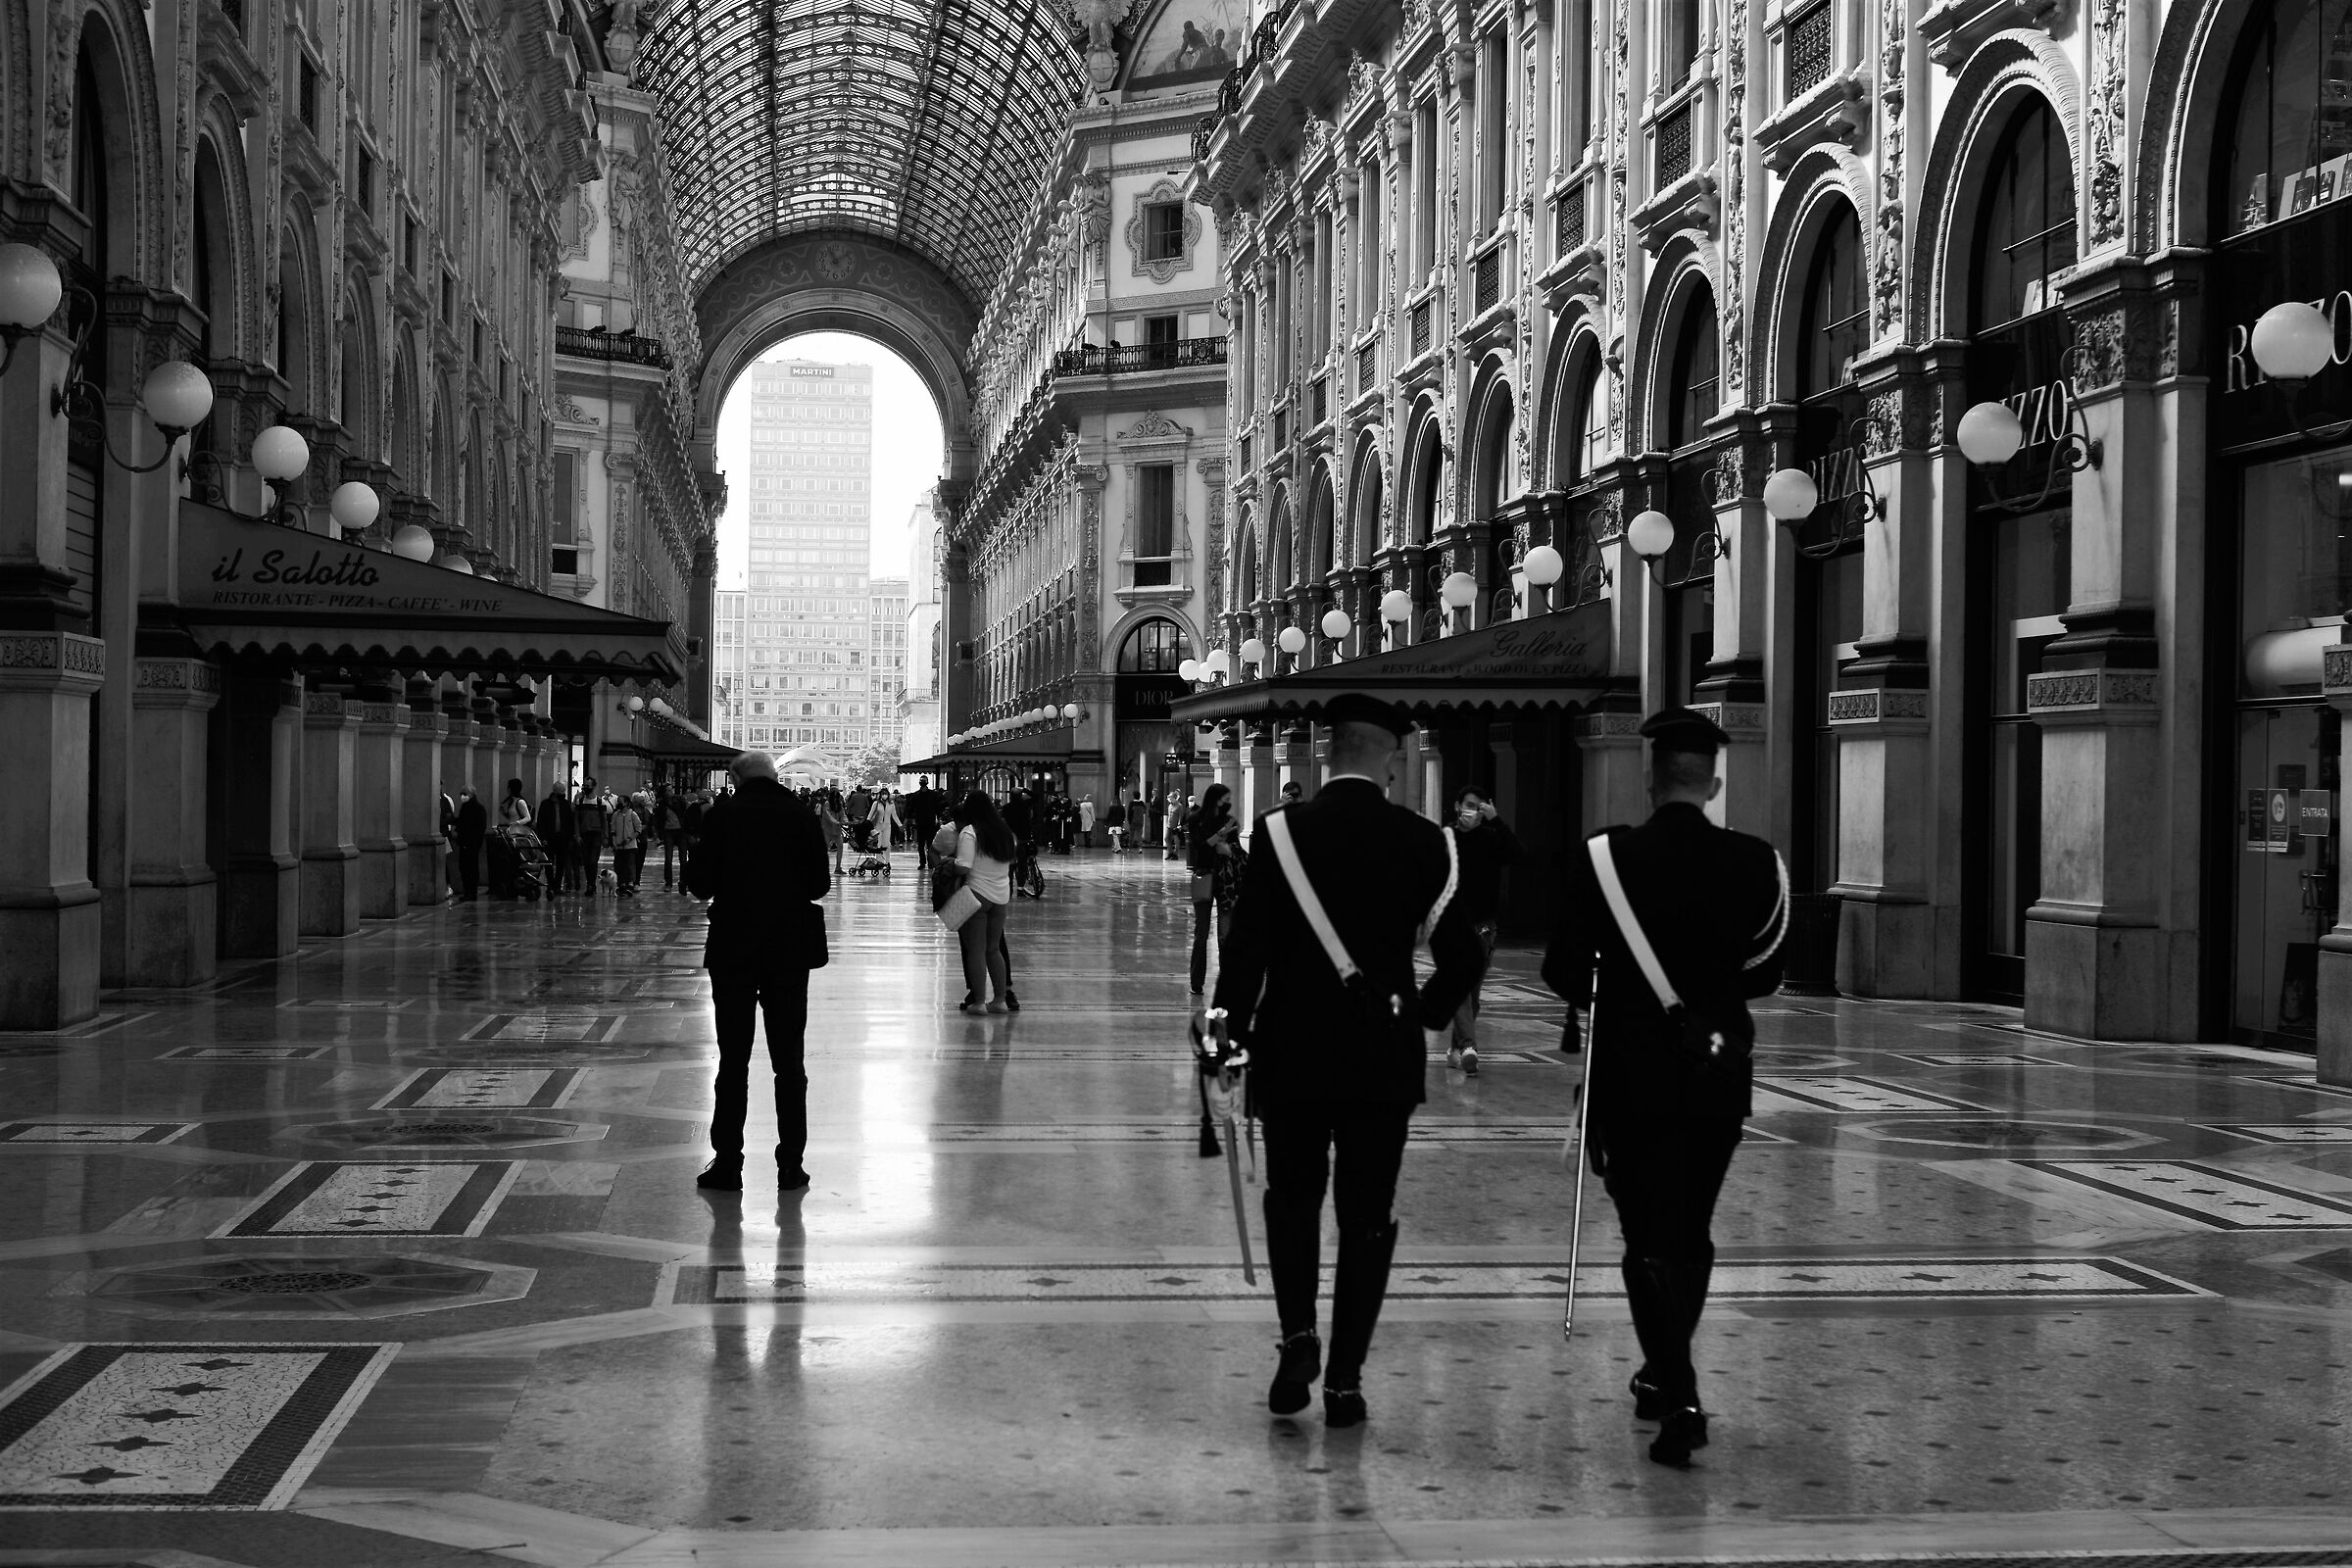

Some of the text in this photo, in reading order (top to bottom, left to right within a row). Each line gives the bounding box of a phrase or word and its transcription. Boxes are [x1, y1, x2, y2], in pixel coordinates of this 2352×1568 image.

[792, 368, 832, 376] MARTINI
[212, 548, 380, 587] il Salotto
[212, 591, 315, 606] RISTORANTE
[328, 594, 375, 608] PIZZA
[459, 598, 503, 612] WINE
[1489, 629, 1590, 658] Galleria
[1380, 663, 1464, 675] RESTAURANT
[1473, 663, 1512, 675] WOOD
[2301, 807, 2329, 818] ENTRATA
